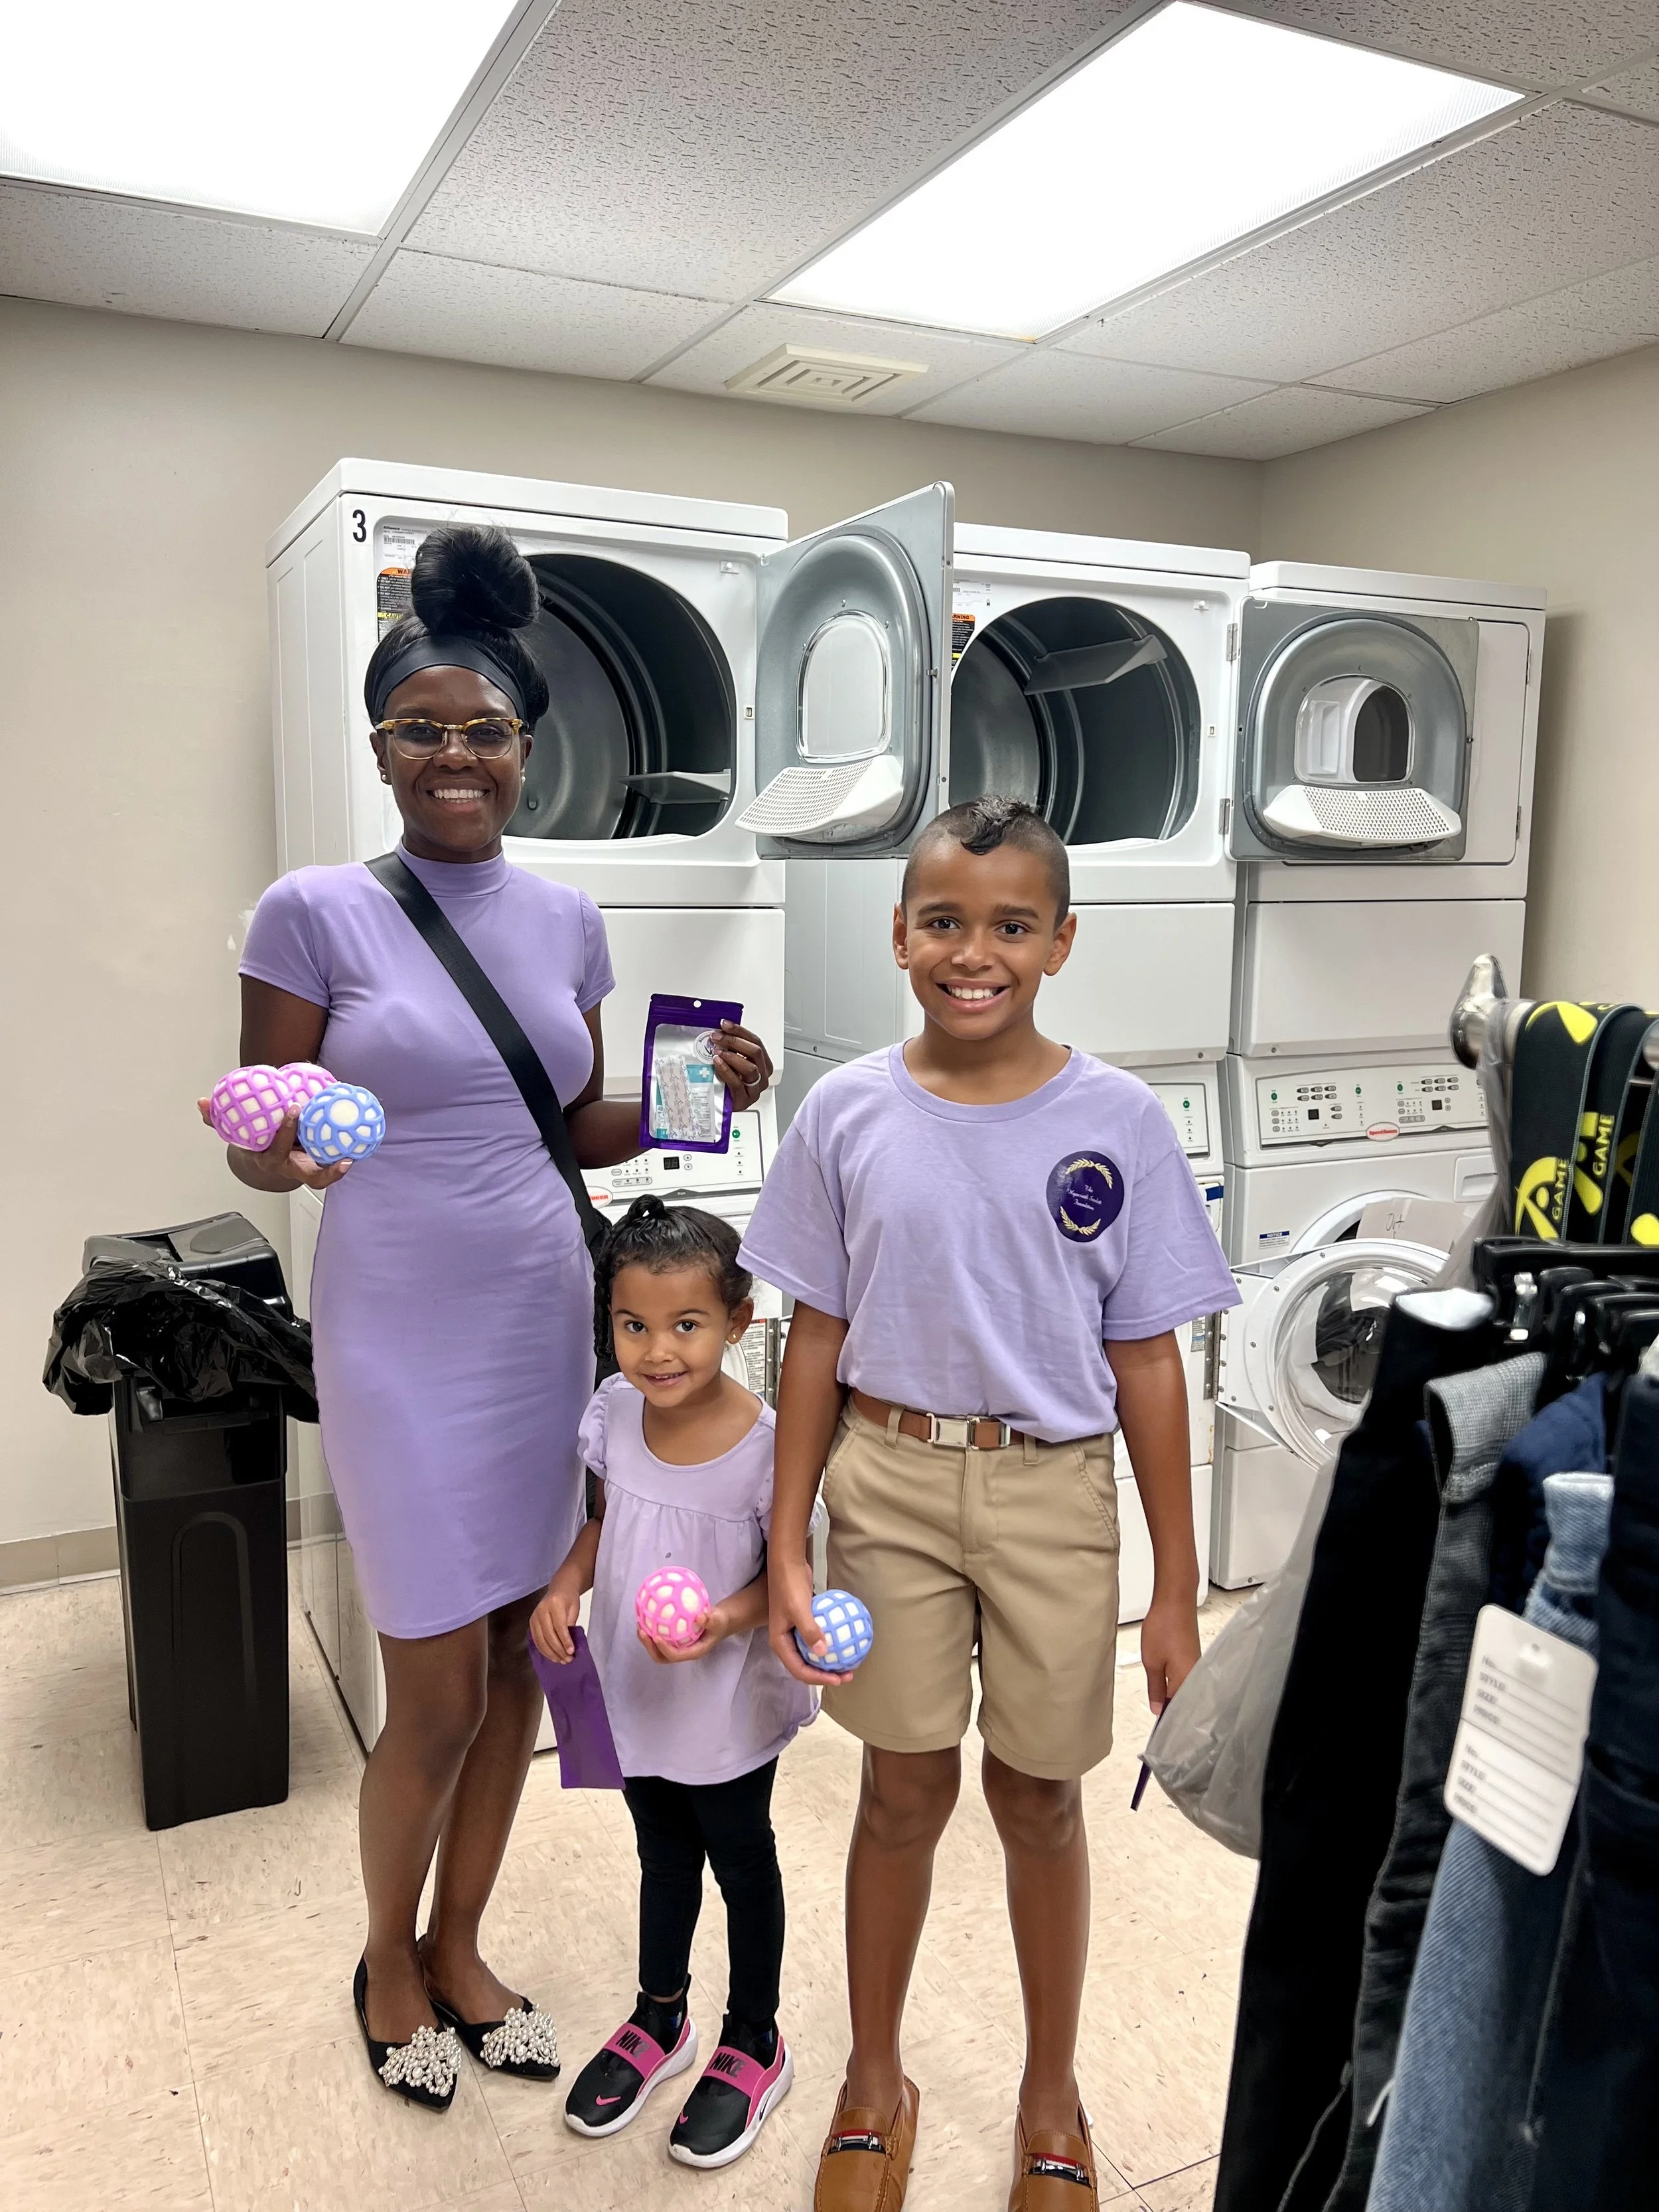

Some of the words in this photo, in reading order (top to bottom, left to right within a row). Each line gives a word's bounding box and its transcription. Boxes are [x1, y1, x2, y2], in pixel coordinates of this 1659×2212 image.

[352, 509, 367, 543] 3
[1593, 1114, 1615, 1176] GAME
[1551, 1158, 1569, 1220] GAME
[616, 2029, 651, 2060] NIKE
[709, 2052, 747, 2079] NIKE
